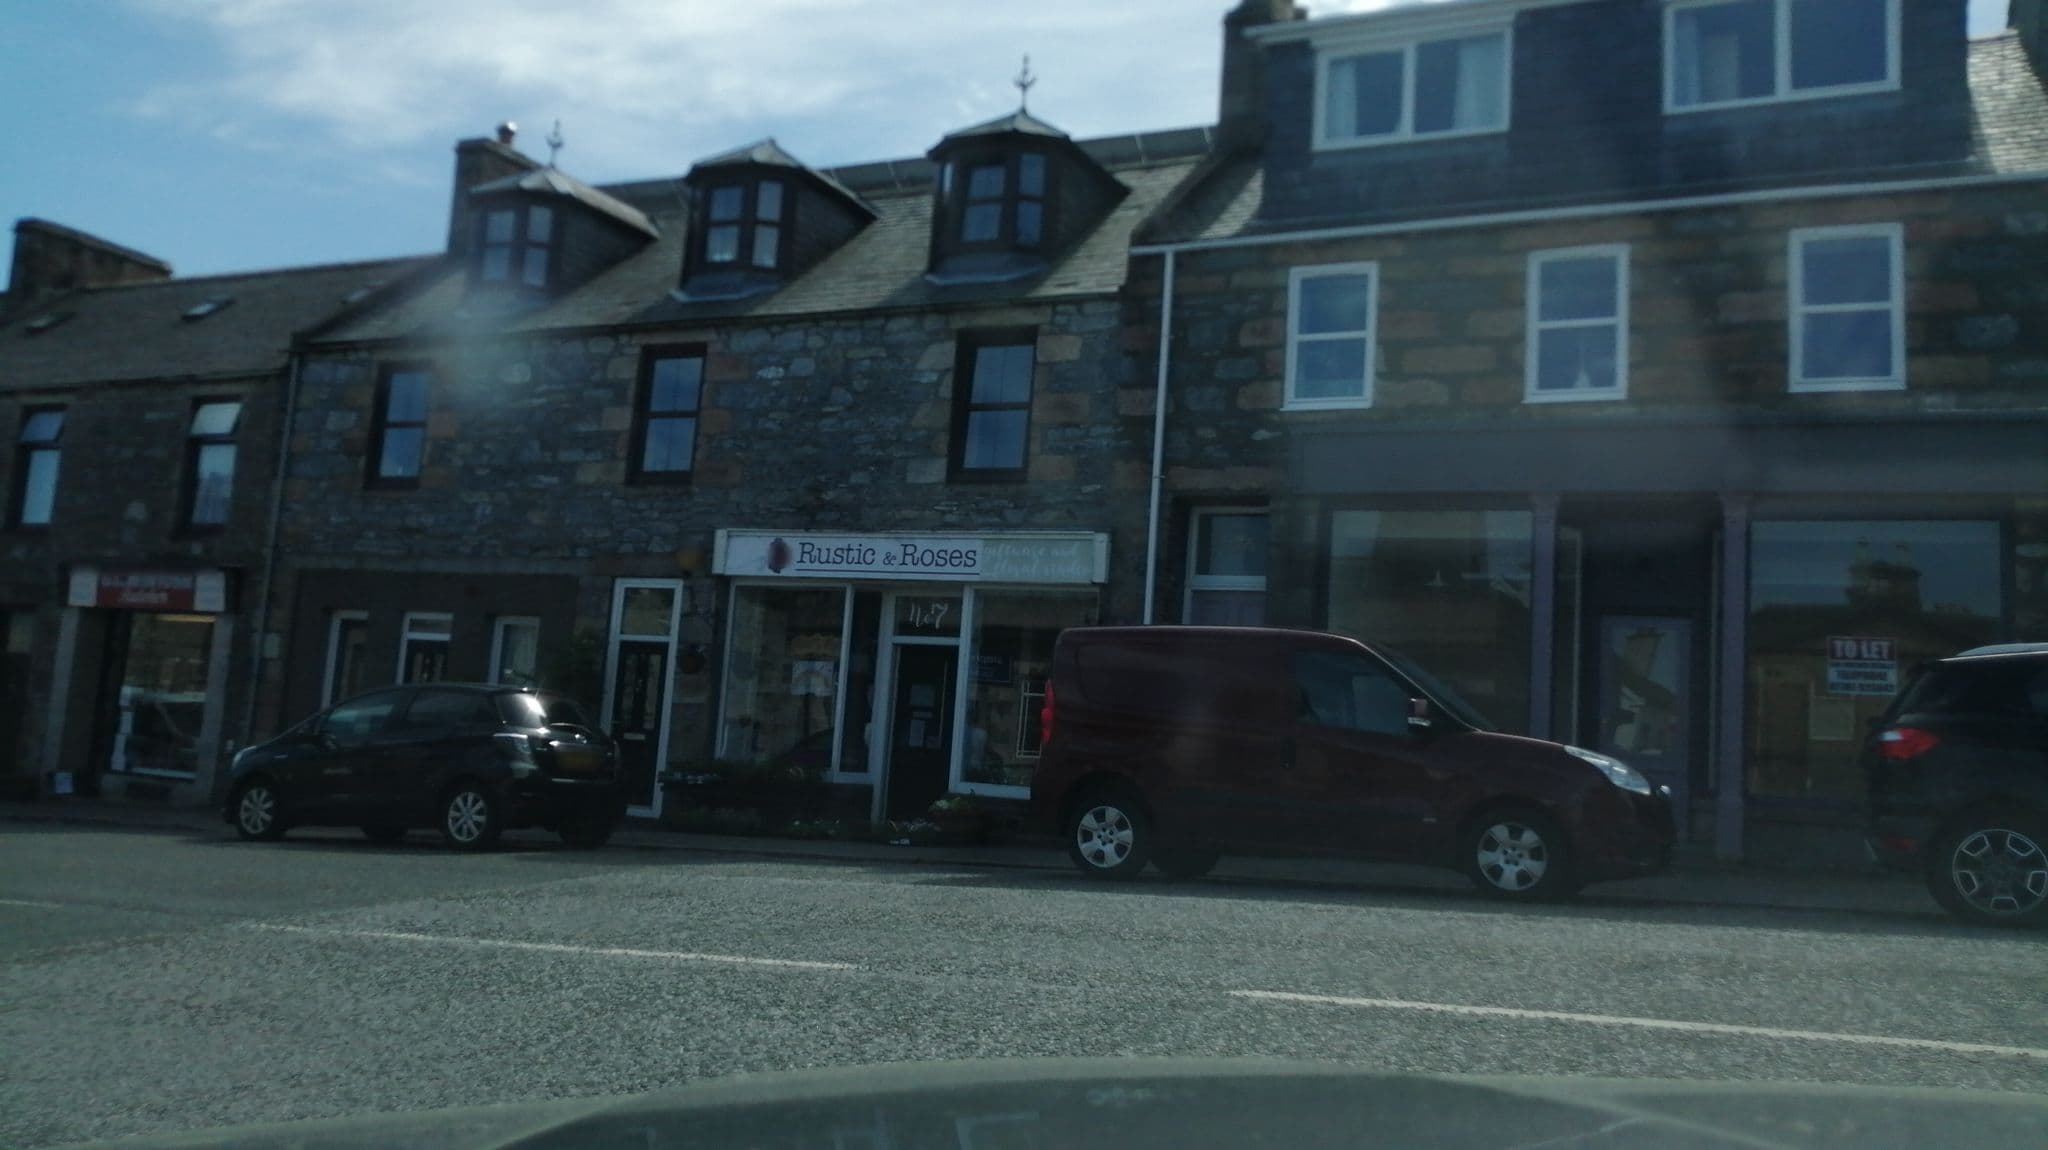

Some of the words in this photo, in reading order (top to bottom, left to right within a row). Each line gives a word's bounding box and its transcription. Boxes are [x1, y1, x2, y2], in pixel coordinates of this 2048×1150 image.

[796, 542, 876, 565] Rustic
[883, 552, 897, 566] &
[899, 543, 977, 568] Roses
[1832, 640, 1857, 658] TO
[1861, 641, 1891, 659] LET
